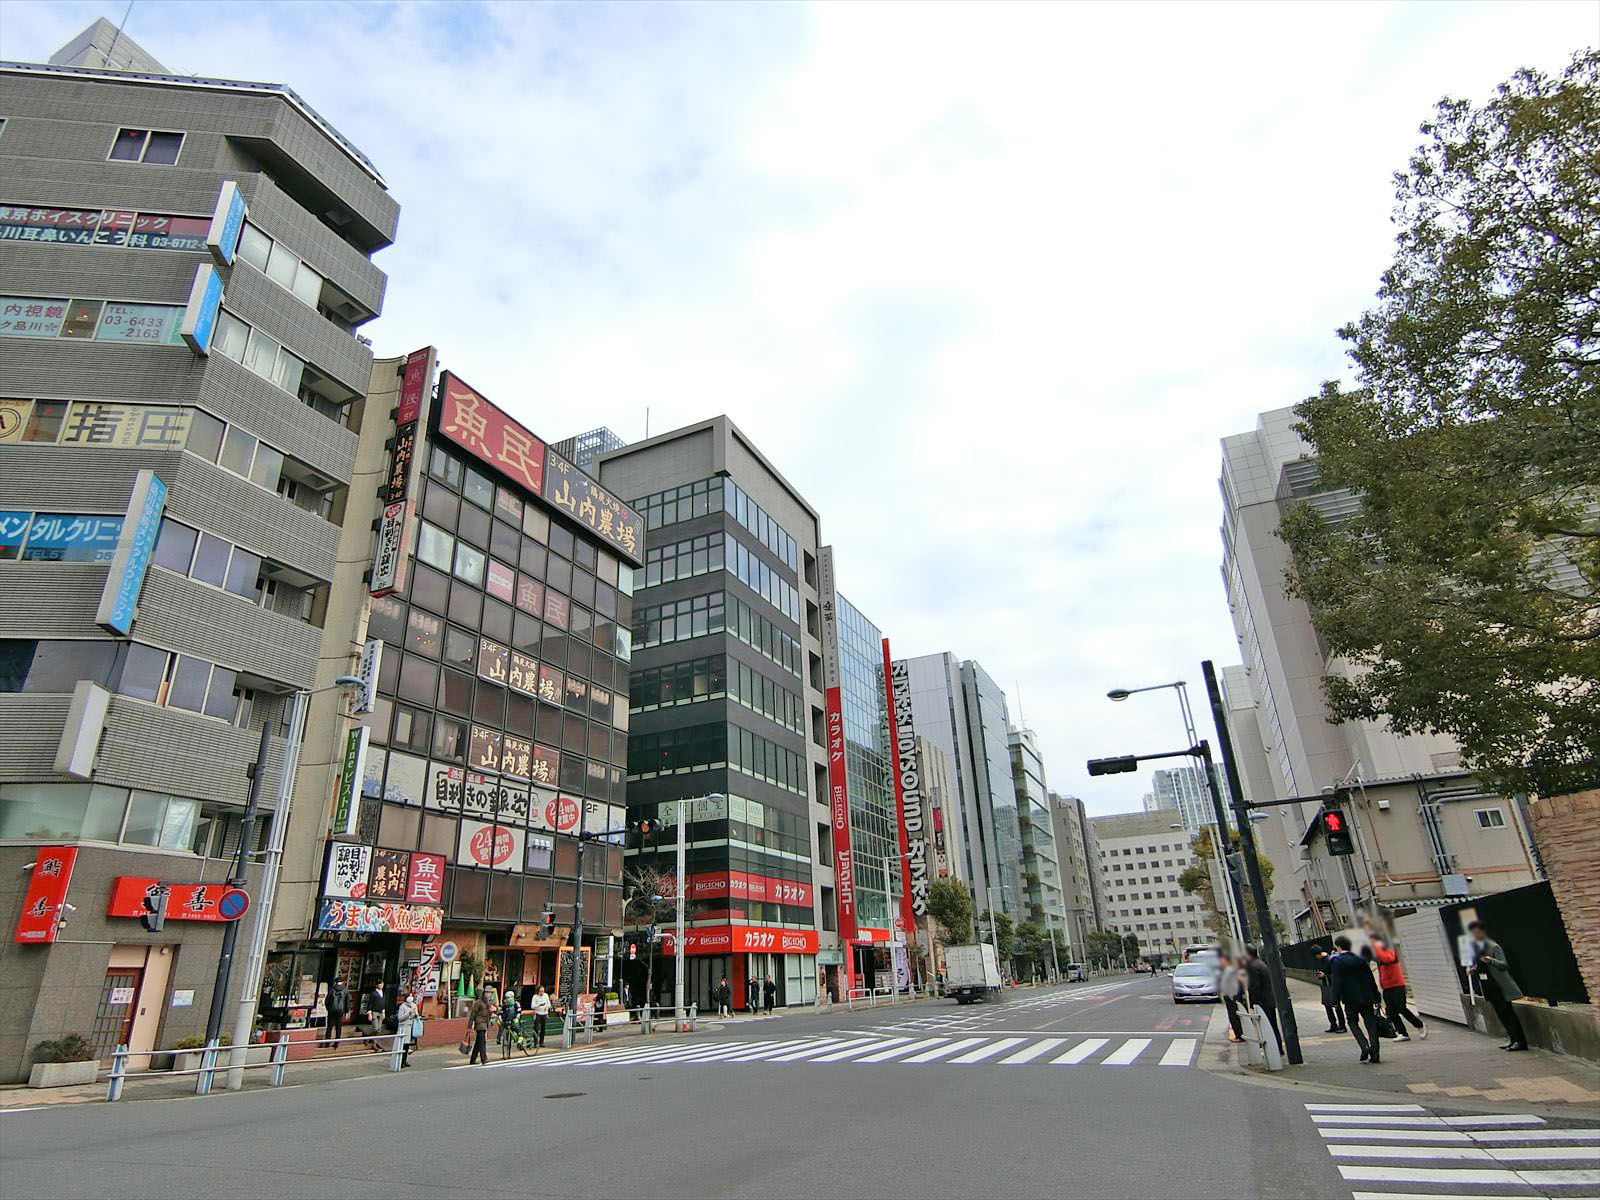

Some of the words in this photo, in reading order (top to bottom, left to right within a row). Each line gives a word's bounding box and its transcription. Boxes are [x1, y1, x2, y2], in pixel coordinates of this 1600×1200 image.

[0, 226, 147, 247] 川耳鼻いんこう科
[446, 390, 540, 490] 魚民
[555, 480, 636, 554] 山内農場
[489, 658, 556, 701] 山内農場
[830, 711, 843, 762] カラオケ
[481, 744, 550, 782] 山内農場
[586, 802, 599, 815] 2F
[411, 857, 440, 902] 魚民
[775, 884, 805, 901] カラオケ
[744, 931, 776, 948] カラオケ
